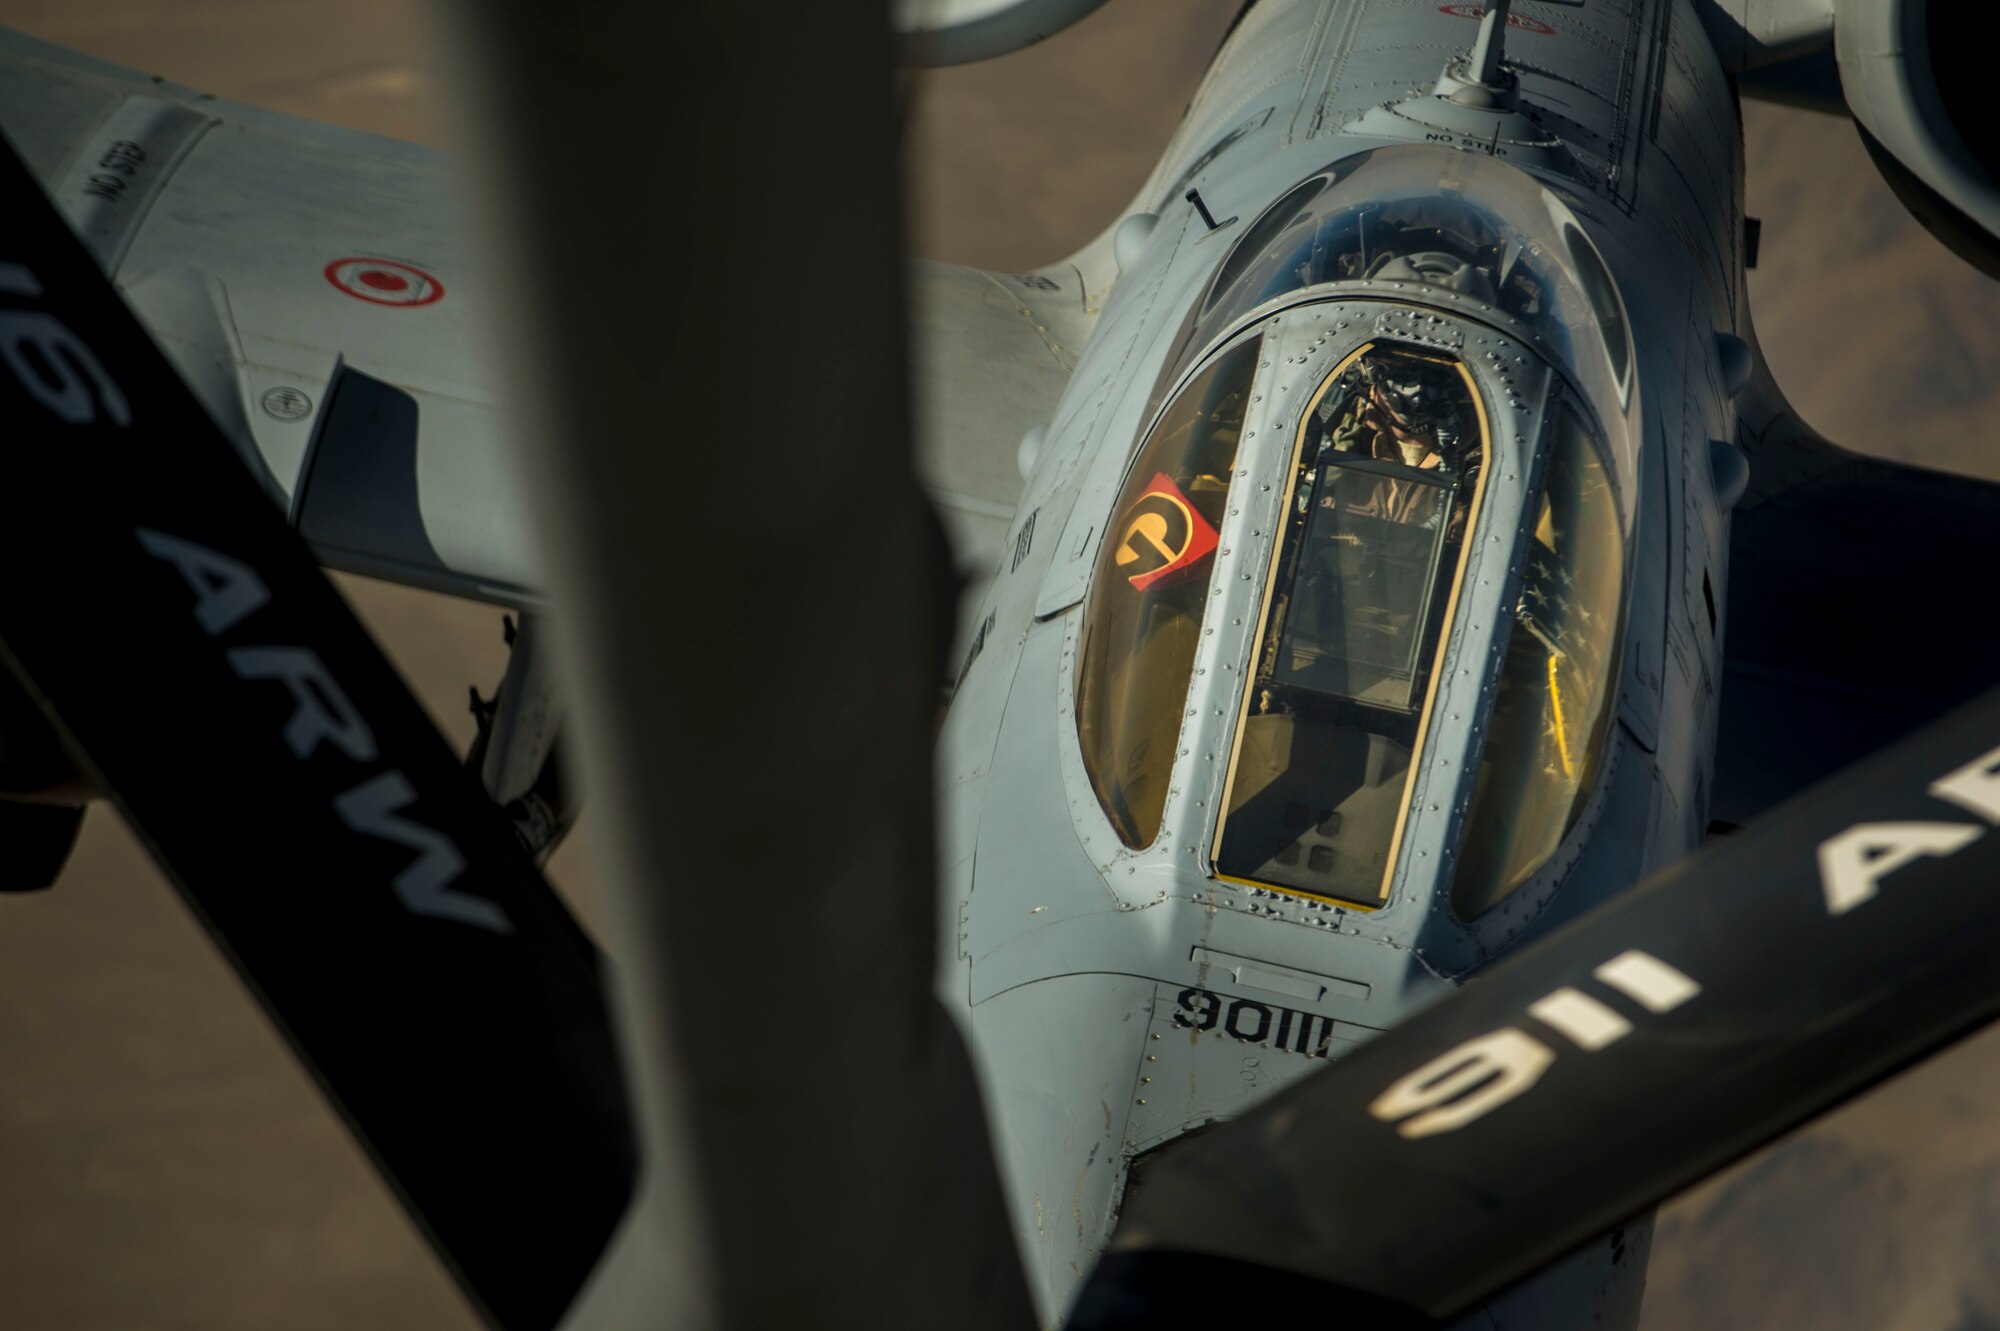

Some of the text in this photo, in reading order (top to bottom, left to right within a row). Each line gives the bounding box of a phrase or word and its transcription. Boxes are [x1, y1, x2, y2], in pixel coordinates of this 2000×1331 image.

[1425, 132, 1453, 143] NO
[133, 524, 519, 936] ARW
[1173, 986, 1335, 1058] 90111
[1367, 949, 1703, 1140] 911
